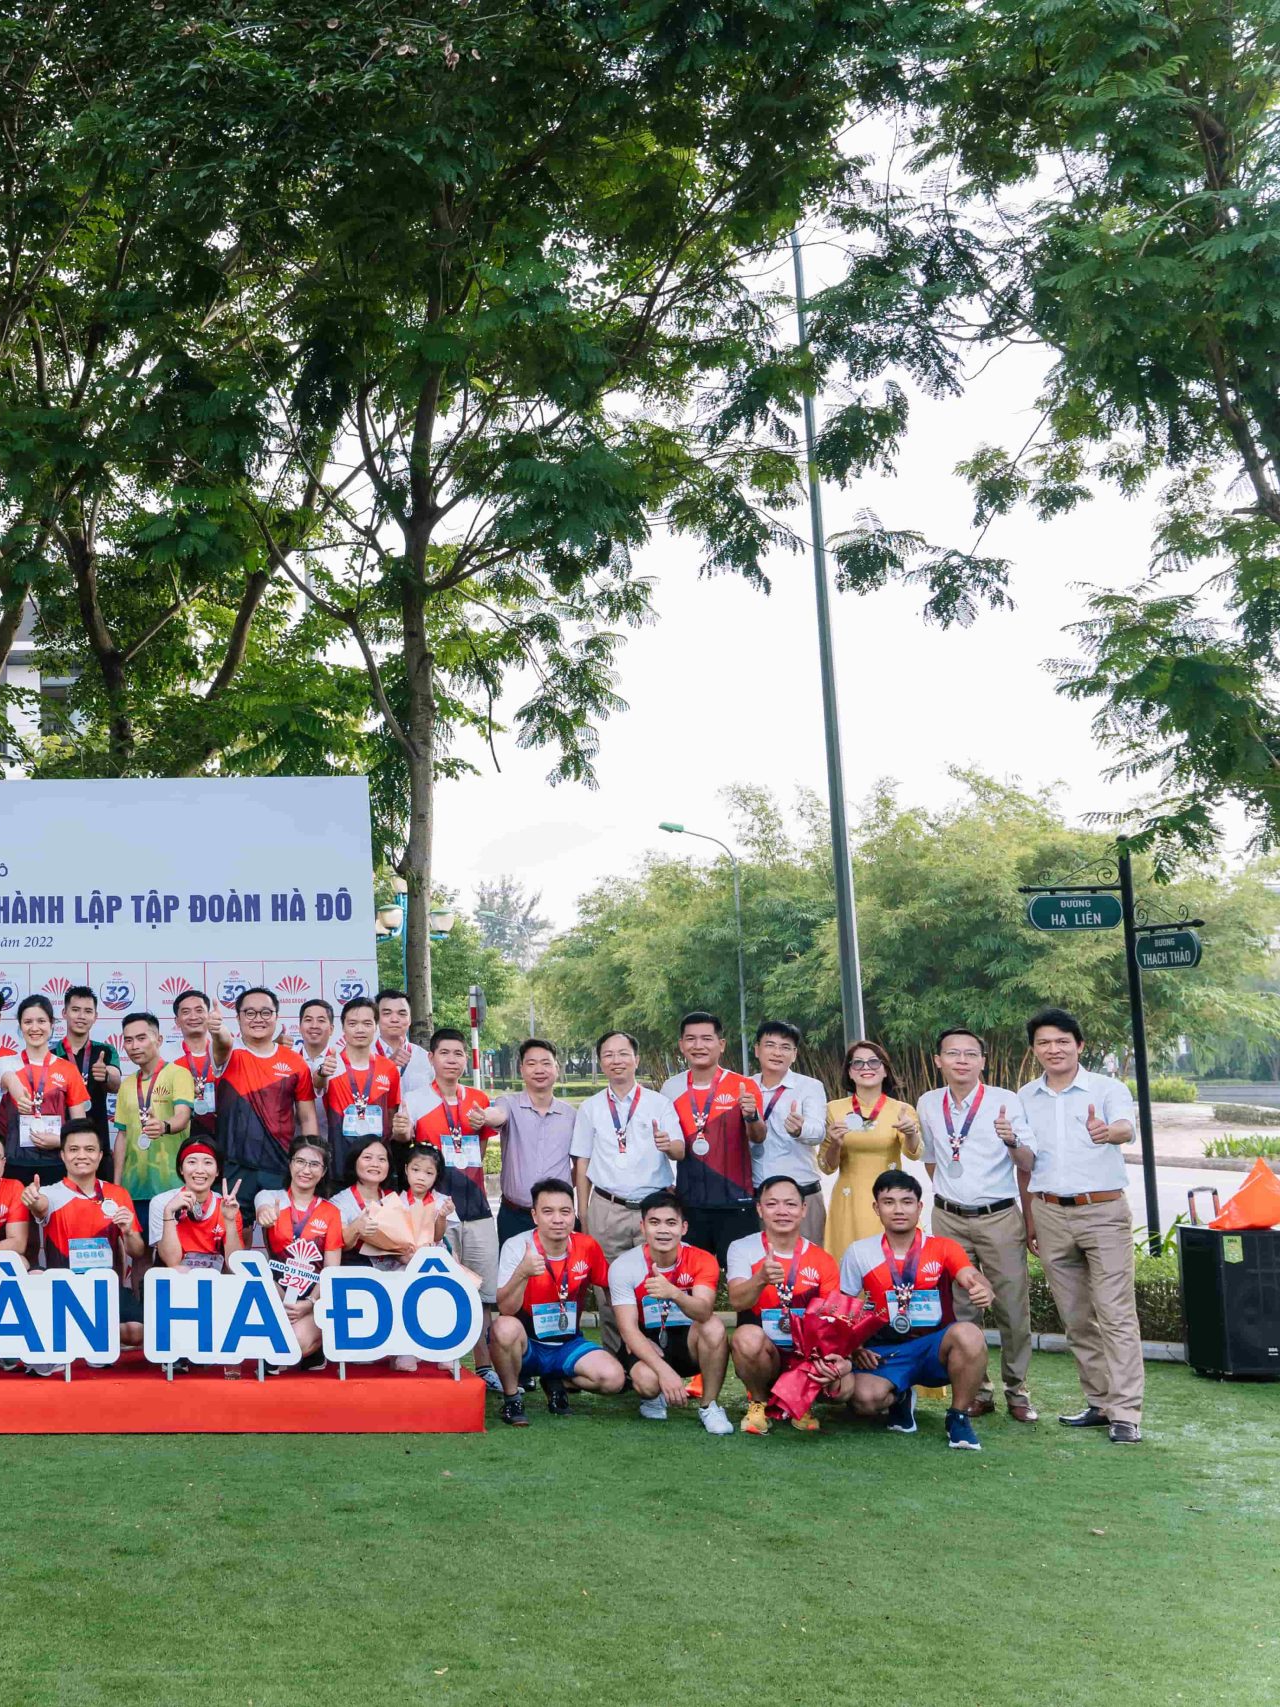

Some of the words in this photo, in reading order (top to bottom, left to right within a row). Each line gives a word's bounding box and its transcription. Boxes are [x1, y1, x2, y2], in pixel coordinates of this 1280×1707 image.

[75, 889, 122, 930] LẬP
[131, 889, 180, 930] TẬP
[188, 888, 261, 923] ĐOÀN
[271, 888, 306, 922] HÀ
[315, 887, 352, 922] ĐÔ
[1051, 913, 1067, 928] HẠ
[1075, 911, 1102, 925] LIÊN
[23, 936, 54, 948] 2022
[1142, 951, 1168, 967] THẠCH
[105, 985, 129, 1002] 32
[222, 985, 246, 1002] 32
[339, 984, 363, 1001] 32
[269, 1261, 290, 1273] HADO
[155, 1261, 290, 1354] HÀ
[325, 1257, 472, 1350] ĐÔ
